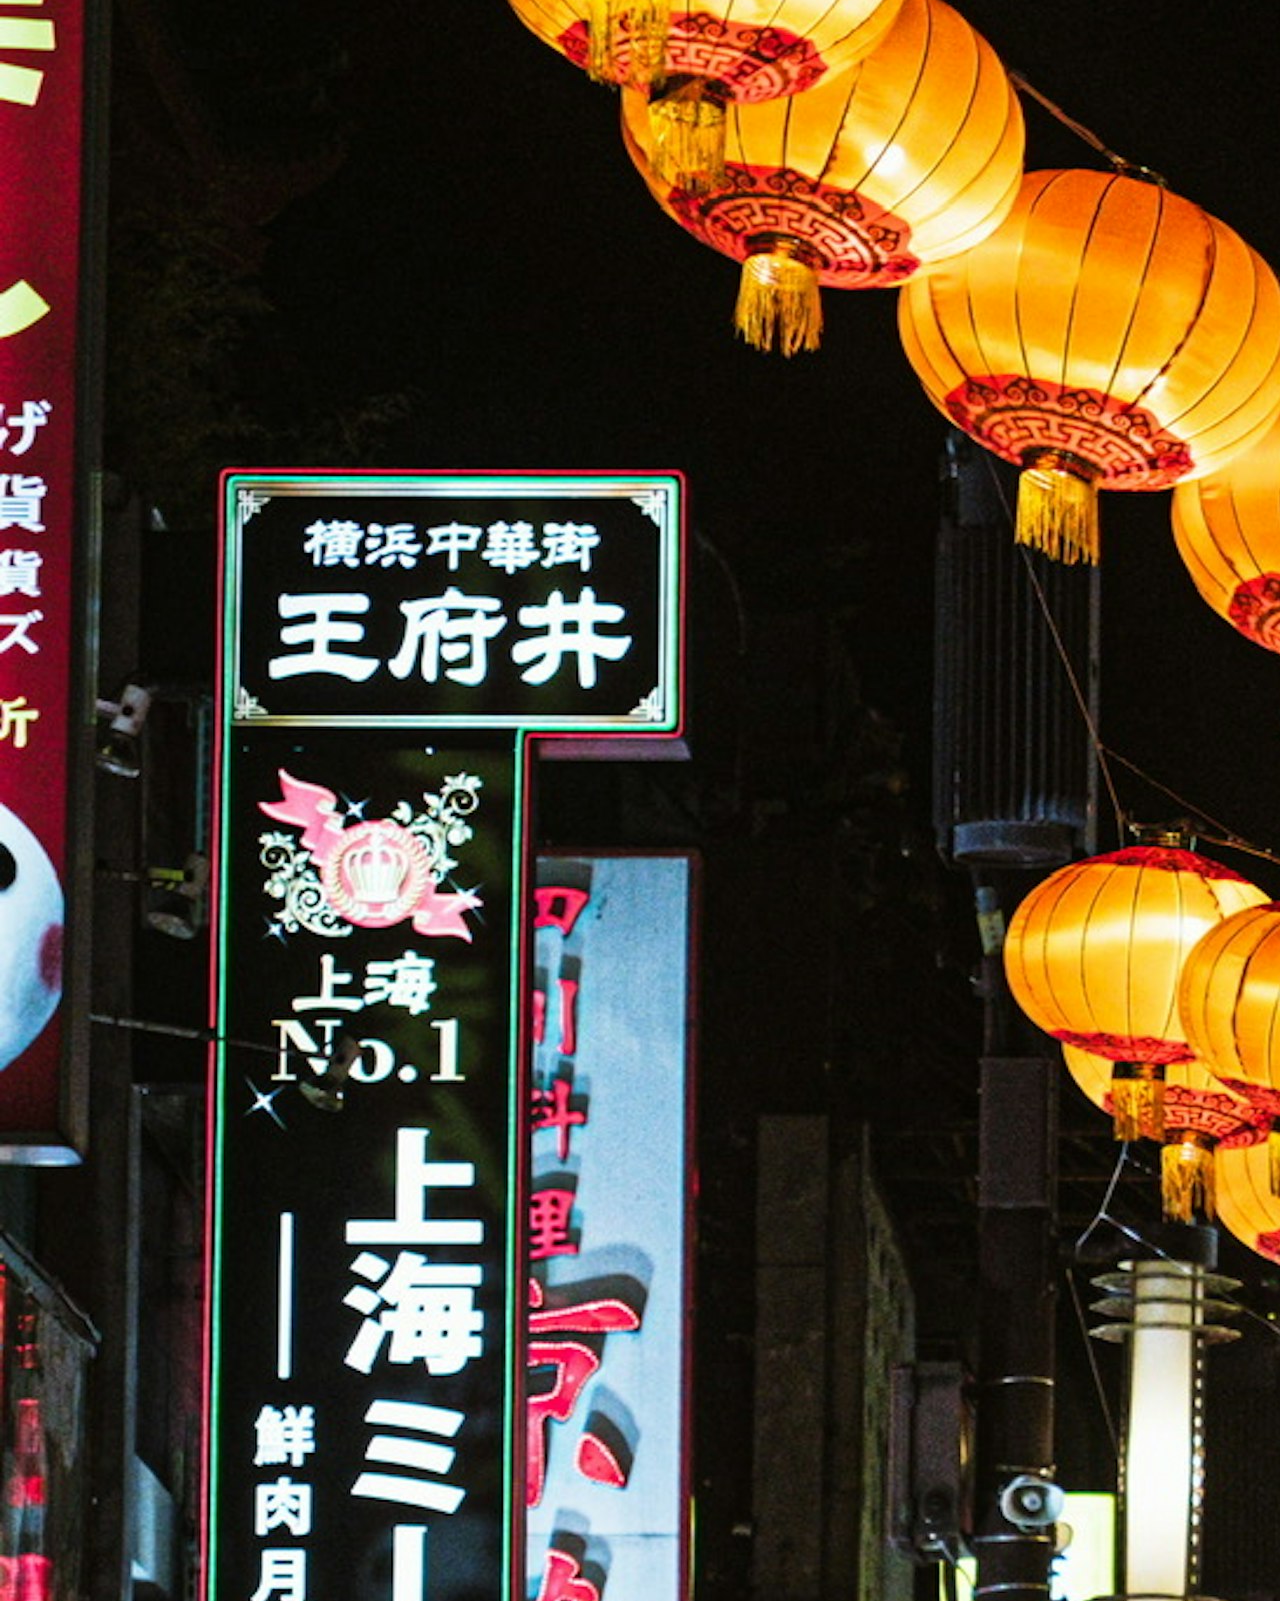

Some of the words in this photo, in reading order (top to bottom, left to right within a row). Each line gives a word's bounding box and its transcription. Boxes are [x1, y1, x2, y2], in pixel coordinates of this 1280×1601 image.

[303, 520, 601, 573] 横浜中華街
[267, 586, 633, 690] 王府井
[291, 950, 437, 1016] 上海
[271, 1017, 467, 1083] No.1
